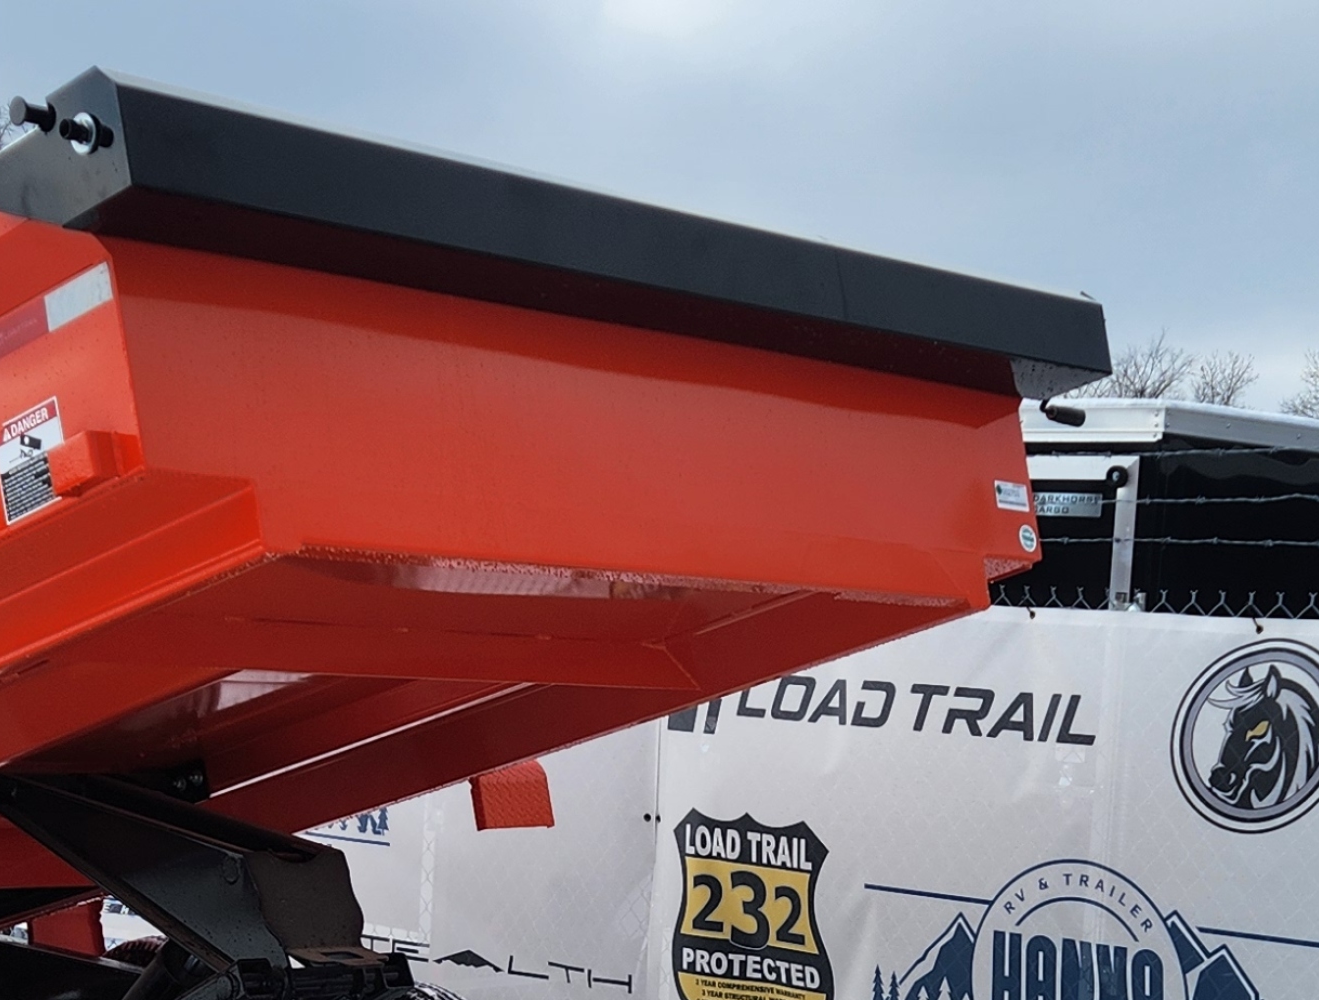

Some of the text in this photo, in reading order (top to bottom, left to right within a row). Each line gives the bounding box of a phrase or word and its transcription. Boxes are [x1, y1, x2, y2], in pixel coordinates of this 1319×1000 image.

[11, 407, 49, 438] DANGER
[737, 675, 1096, 746] LOAD TRAIL
[685, 823, 812, 871] LOAD TRAIL
[692, 870, 806, 949] 232
[1003, 873, 1154, 933] RV & TRAILER
[682, 947, 821, 989] PROTECTED
[701, 979, 717, 988] YEAR
[718, 980, 775, 995] COMPREHENSIVE
[775, 987, 806, 1000] WARRANTY
[707, 989, 723, 999] YEAR
